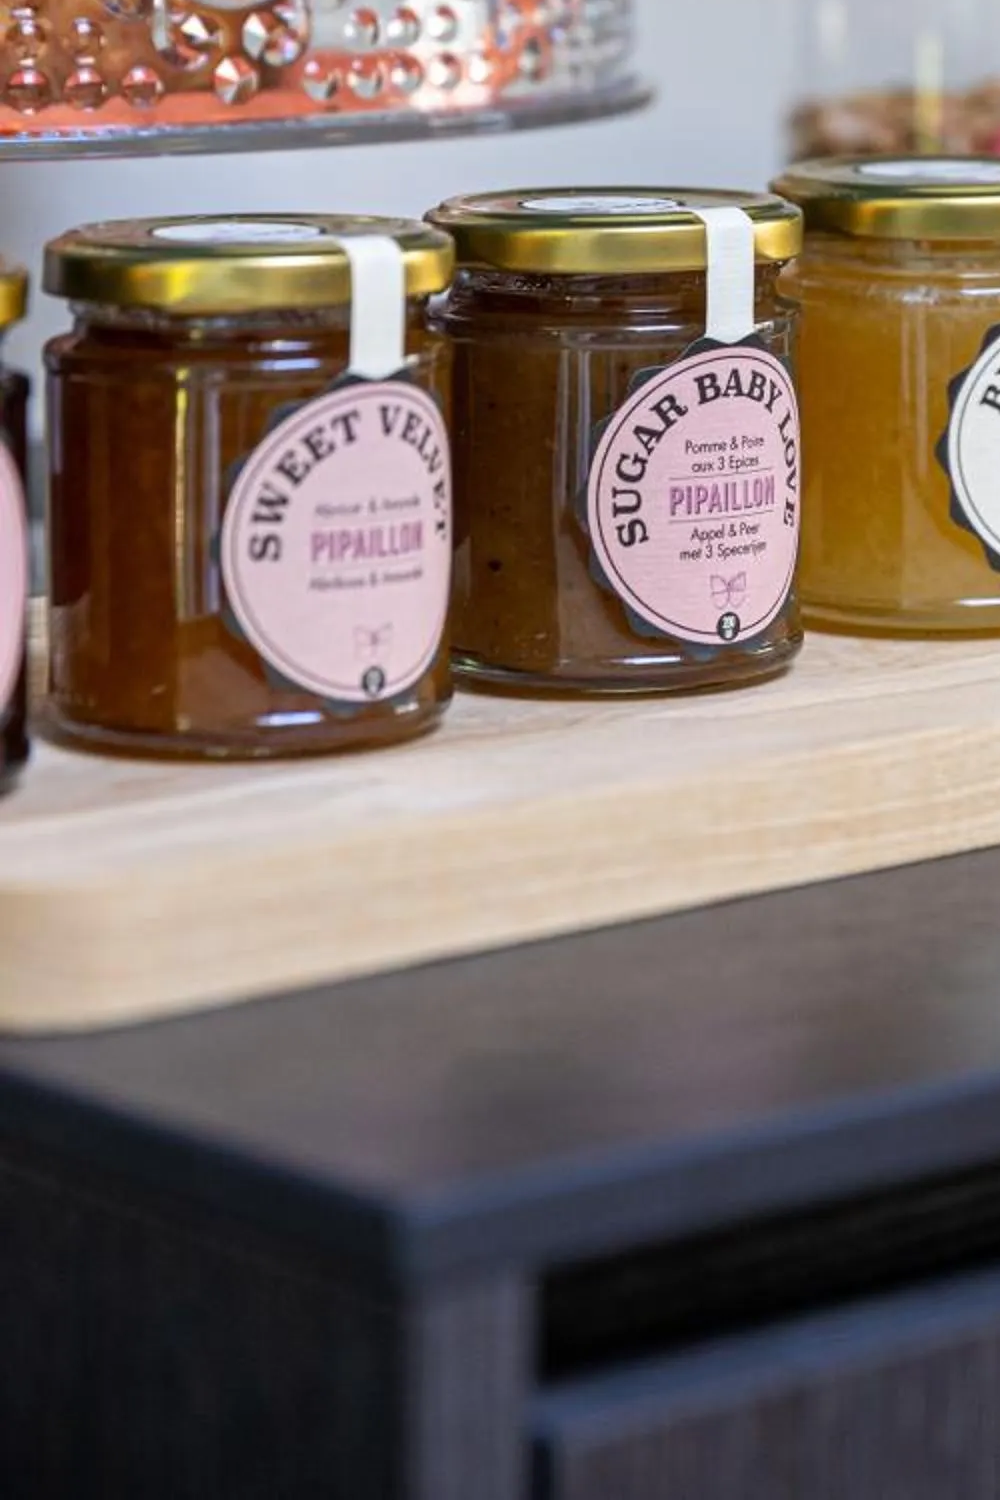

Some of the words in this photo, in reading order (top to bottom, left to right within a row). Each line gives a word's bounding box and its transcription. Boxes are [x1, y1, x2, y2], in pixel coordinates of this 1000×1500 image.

[612, 392, 689, 548] SUGAR
[694, 368, 783, 413] BABY
[685, 439, 727, 455] Pomme
[730, 435, 739, 451] &
[691, 461, 714, 473] aux
[718, 455, 725, 471] 3
[249, 408, 361, 562] SWEET
[669, 474, 775, 517] PIPAILLON
[311, 520, 422, 562] PIPAILLON
[690, 524, 725, 545] Appel
[728, 523, 737, 538] &
[679, 547, 702, 562] met
[705, 543, 713, 559] 3
